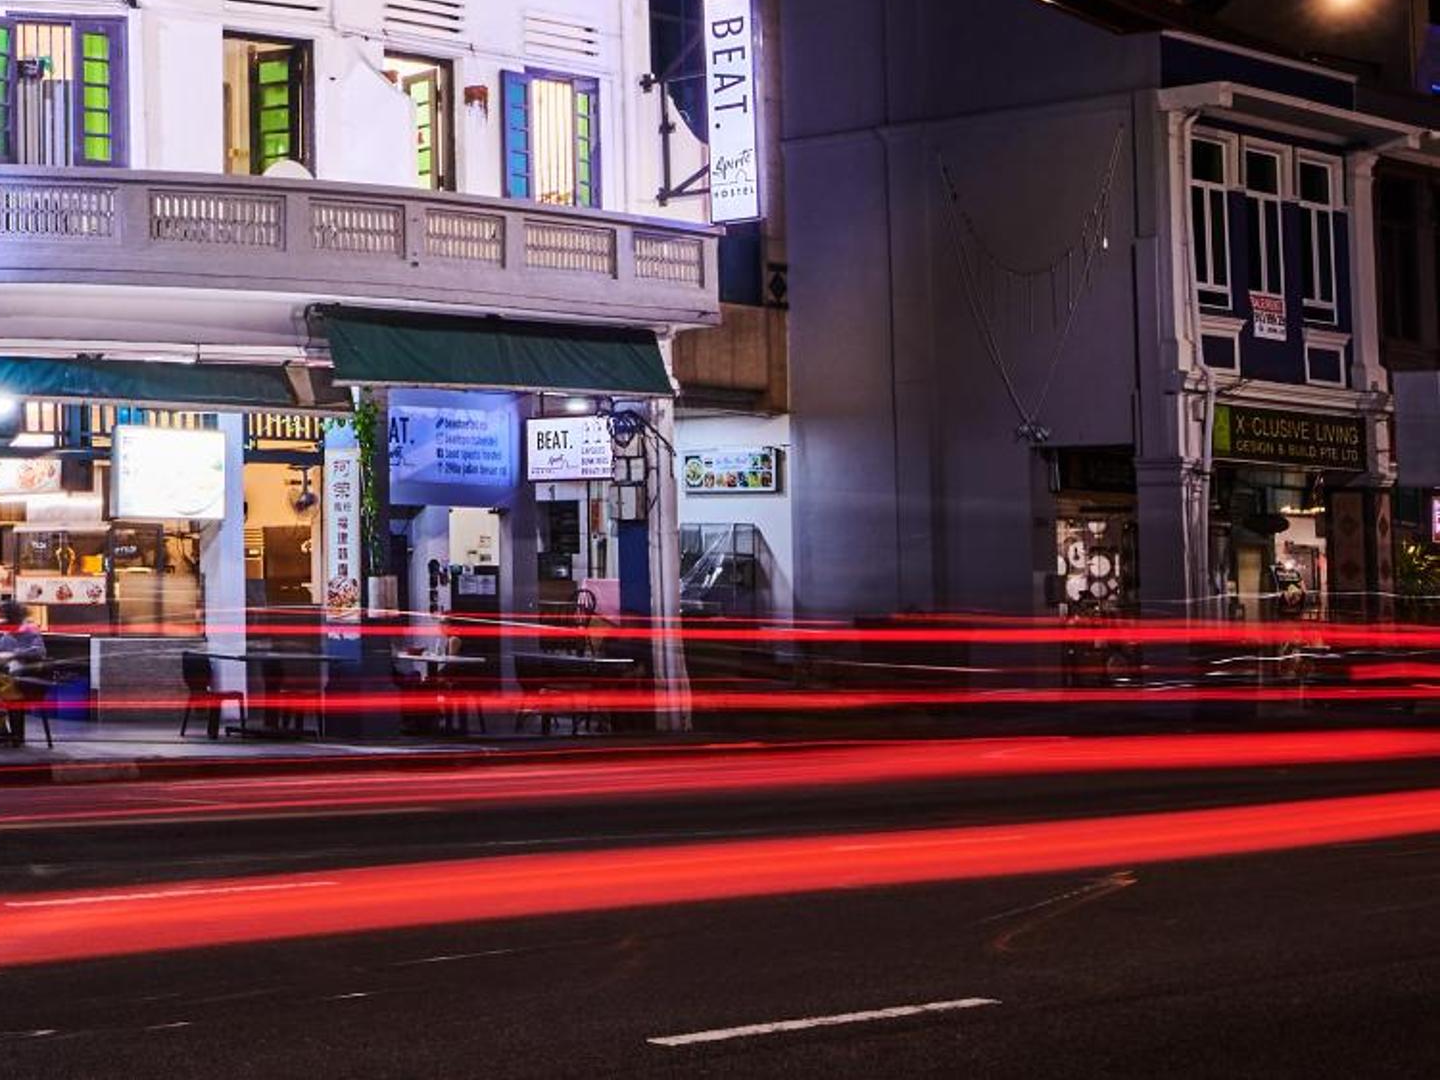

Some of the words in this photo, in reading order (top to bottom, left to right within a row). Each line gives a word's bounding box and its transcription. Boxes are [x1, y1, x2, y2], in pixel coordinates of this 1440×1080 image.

[711, 16, 748, 129] BEAT.
[537, 430, 573, 450] BEAT.
[1316, 423, 1359, 445] LIVING
[1341, 449, 1359, 462] LTD
